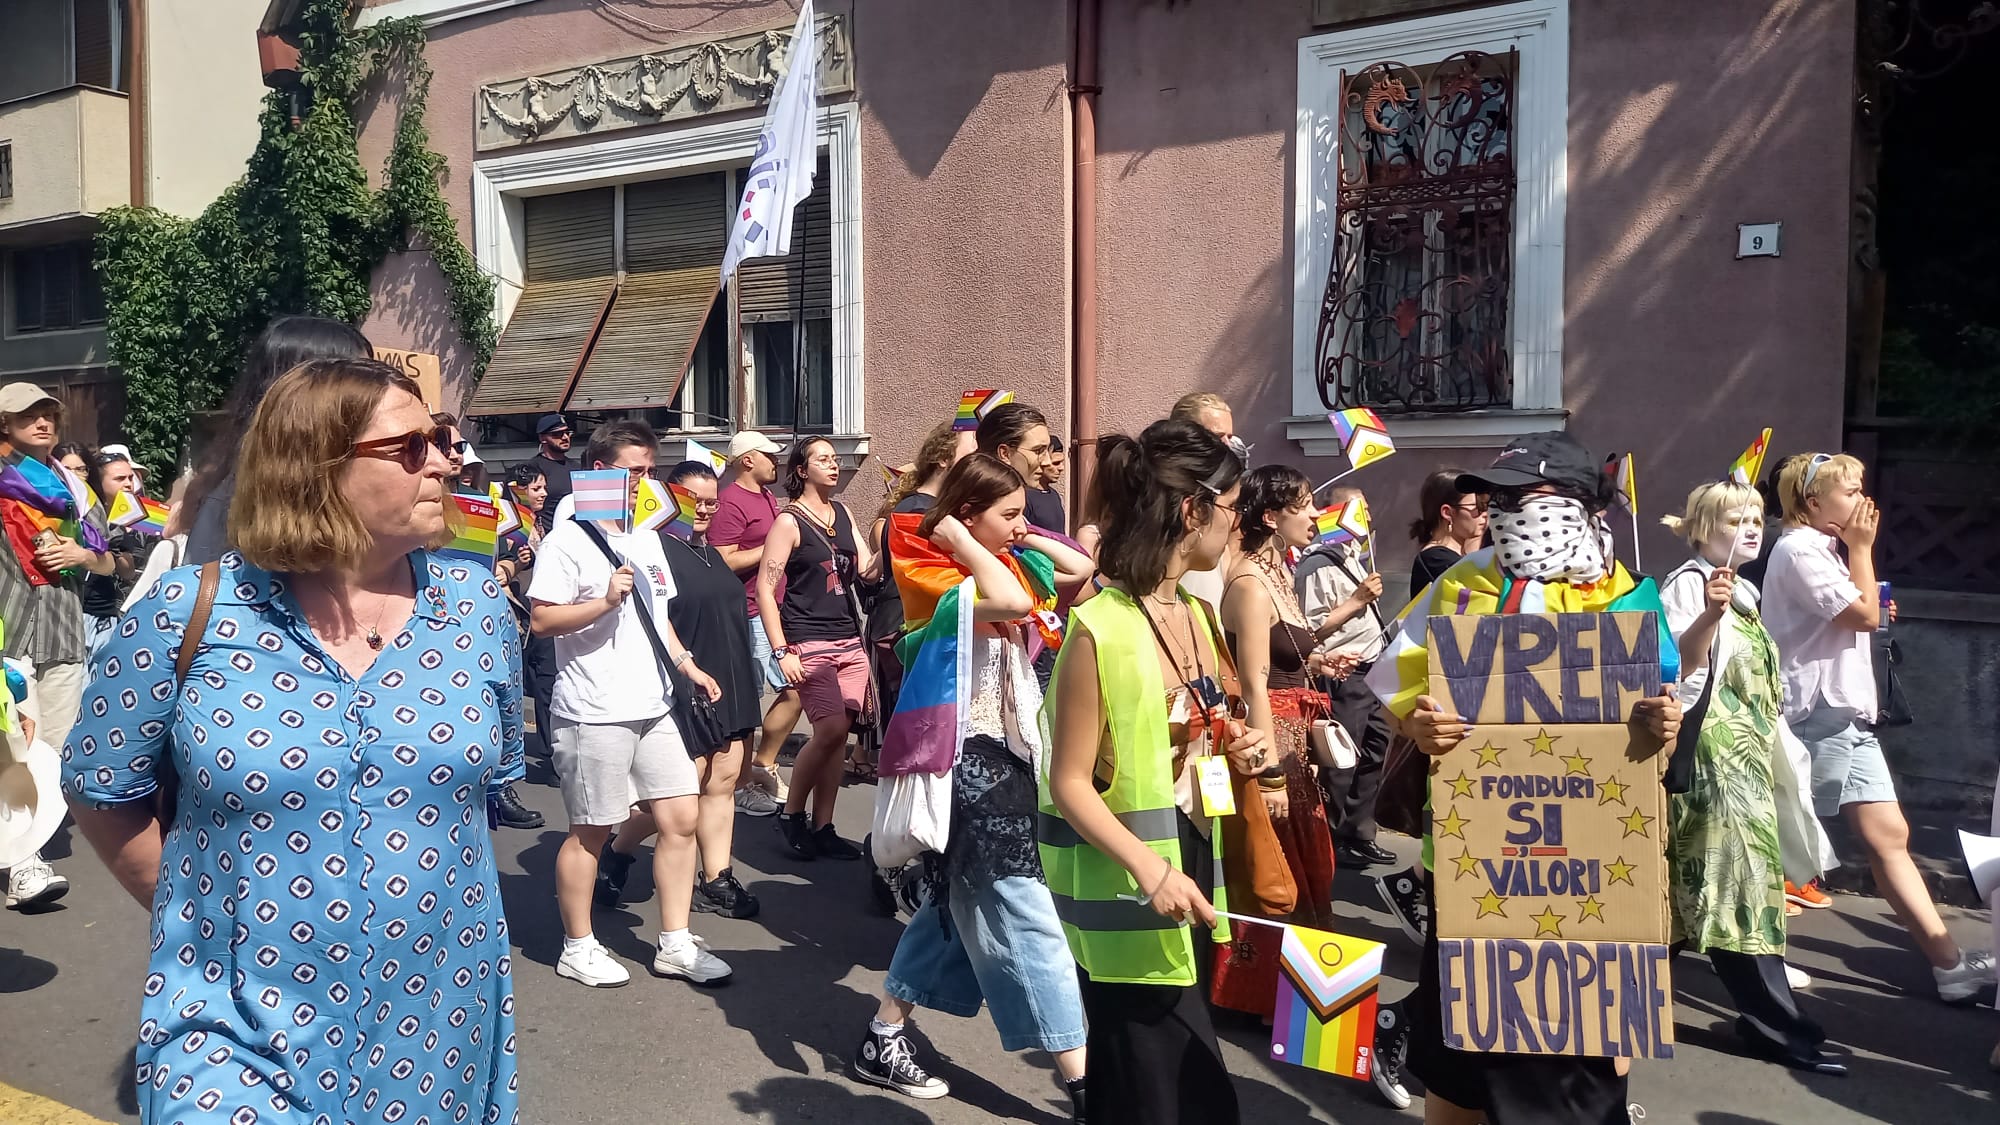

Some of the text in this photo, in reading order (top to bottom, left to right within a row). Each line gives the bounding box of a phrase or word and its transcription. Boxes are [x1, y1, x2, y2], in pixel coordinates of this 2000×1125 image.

[1753, 236, 1763, 250] 9
[1430, 611, 1661, 723] VREM
[1481, 775, 1594, 799] FONDURI
[1480, 858, 1600, 896] VALORI
[1440, 938, 1674, 1058] EUROPENE
